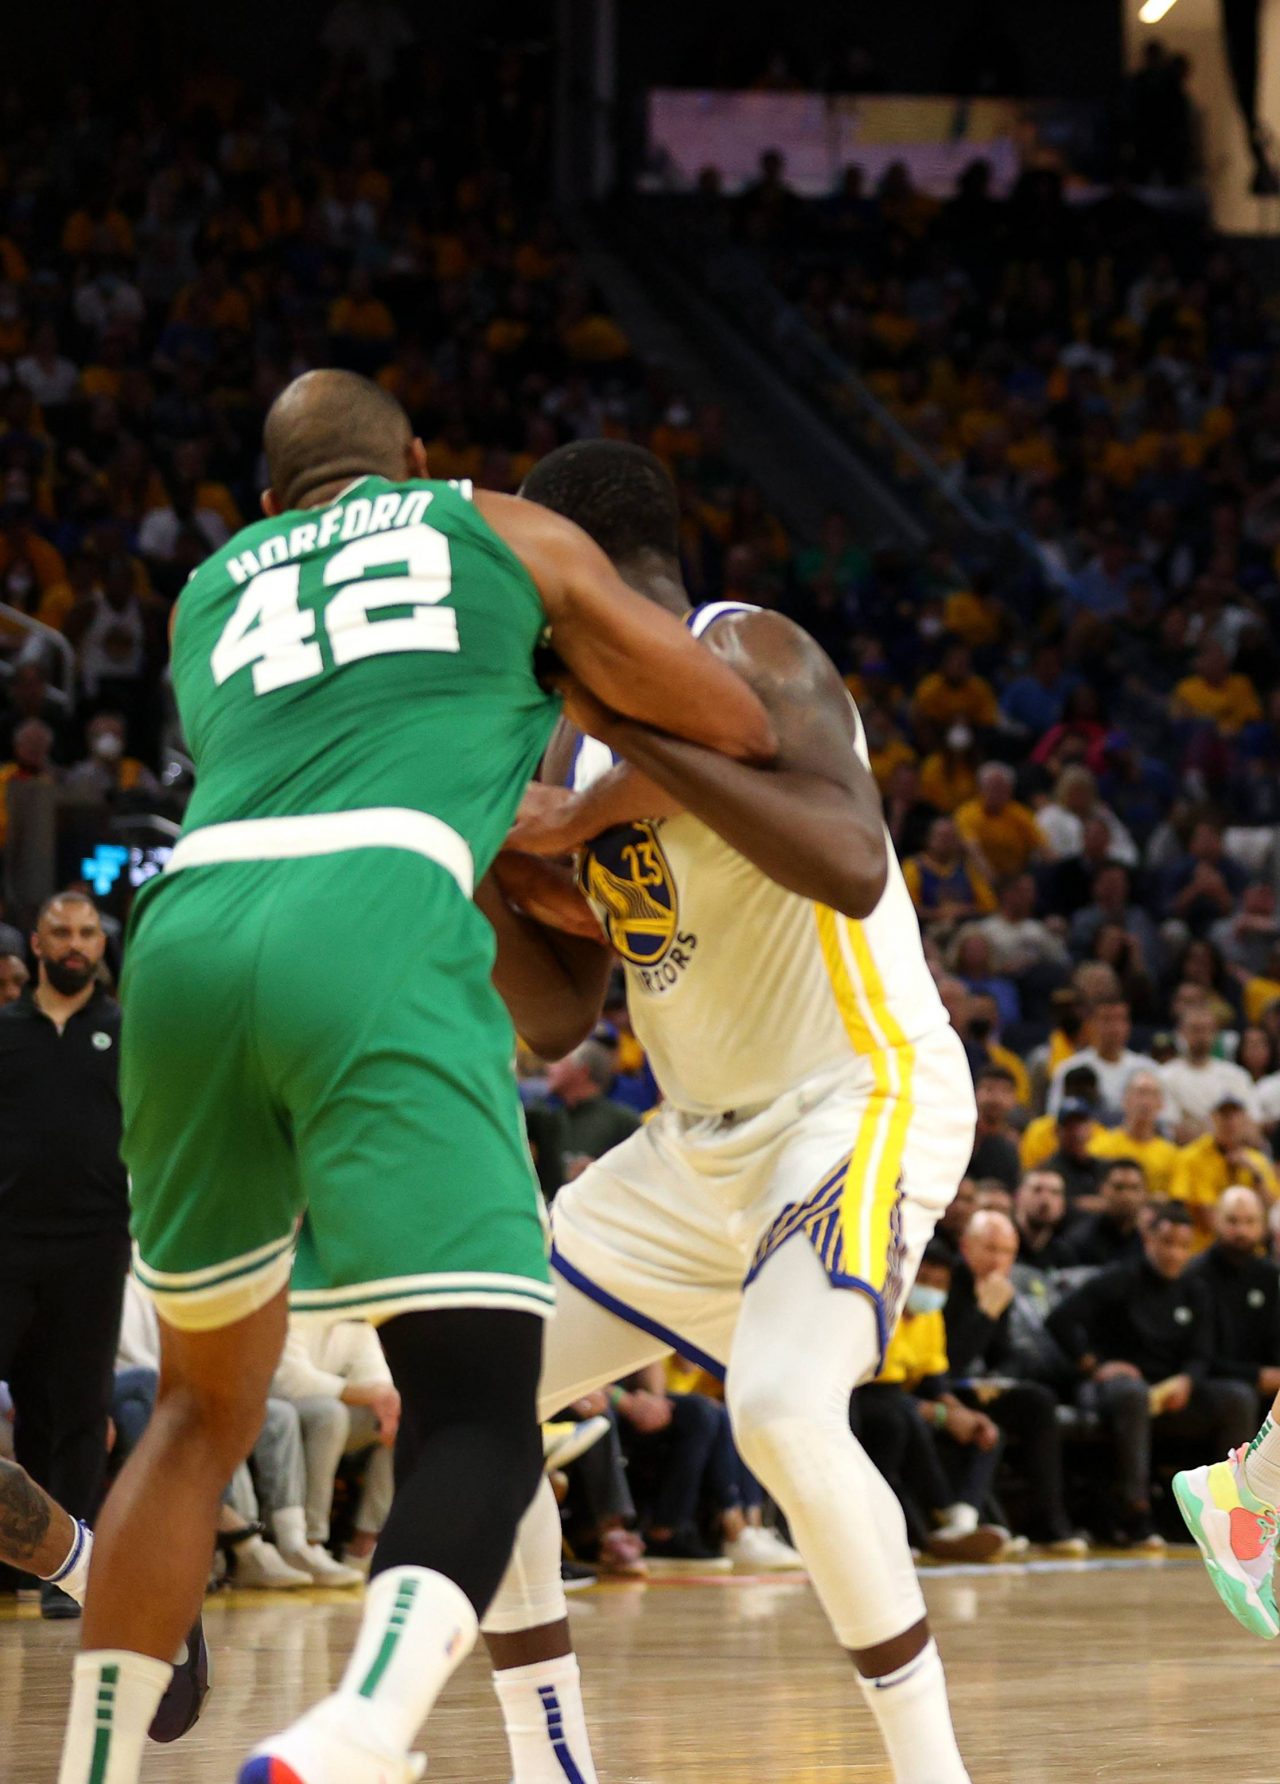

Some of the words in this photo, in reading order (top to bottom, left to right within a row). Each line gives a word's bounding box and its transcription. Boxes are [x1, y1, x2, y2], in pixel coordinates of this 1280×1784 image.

[226, 490, 434, 585] HORFORD
[210, 523, 460, 696] 42
[621, 842, 664, 887] 23
[638, 930, 699, 993] RIORS
